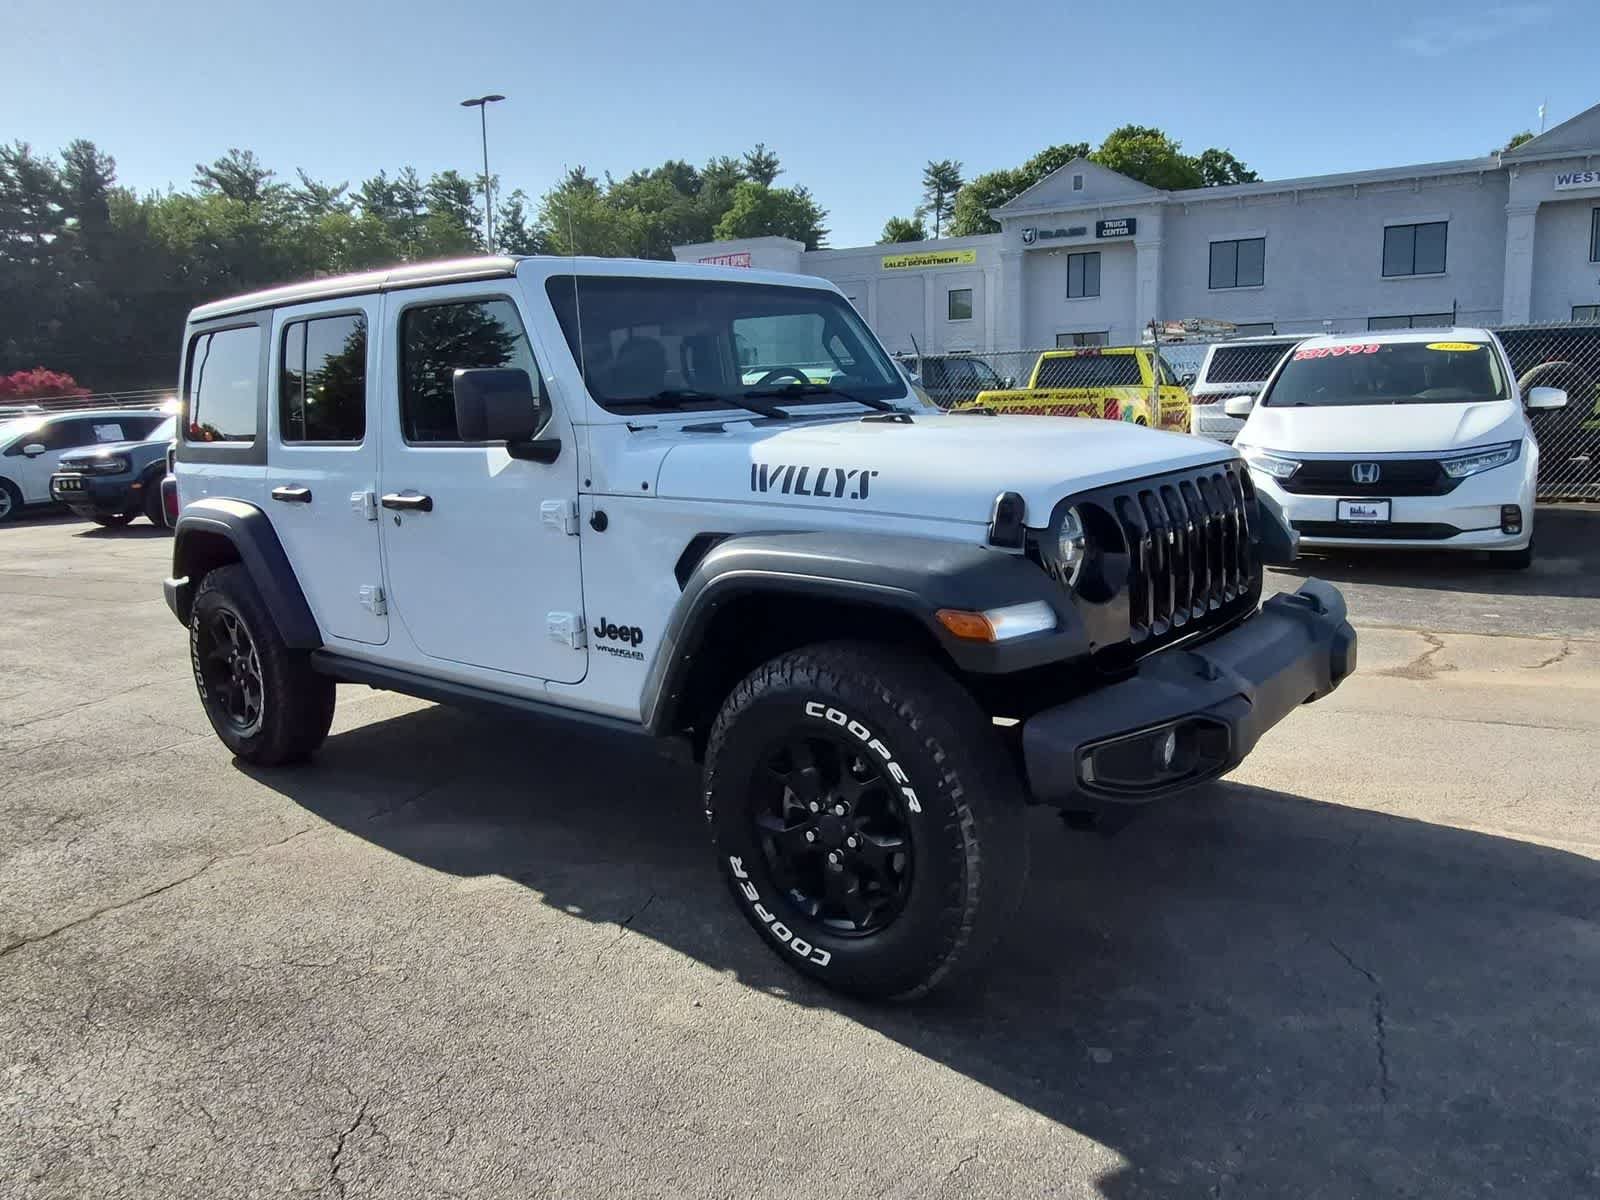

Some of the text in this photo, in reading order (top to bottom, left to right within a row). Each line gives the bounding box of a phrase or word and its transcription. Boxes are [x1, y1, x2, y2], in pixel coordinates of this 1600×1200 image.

[1102, 228, 1129, 237] CENTER
[883, 259, 907, 269] SALES
[908, 256, 959, 267] DEPARTMENT
[751, 463, 879, 500] WILLYS
[593, 616, 644, 648] Jeep
[192, 615, 208, 699] COOPER
[595, 644, 645, 659] WRANGLER
[804, 700, 923, 814] COOPER
[729, 854, 832, 968] COOPER
